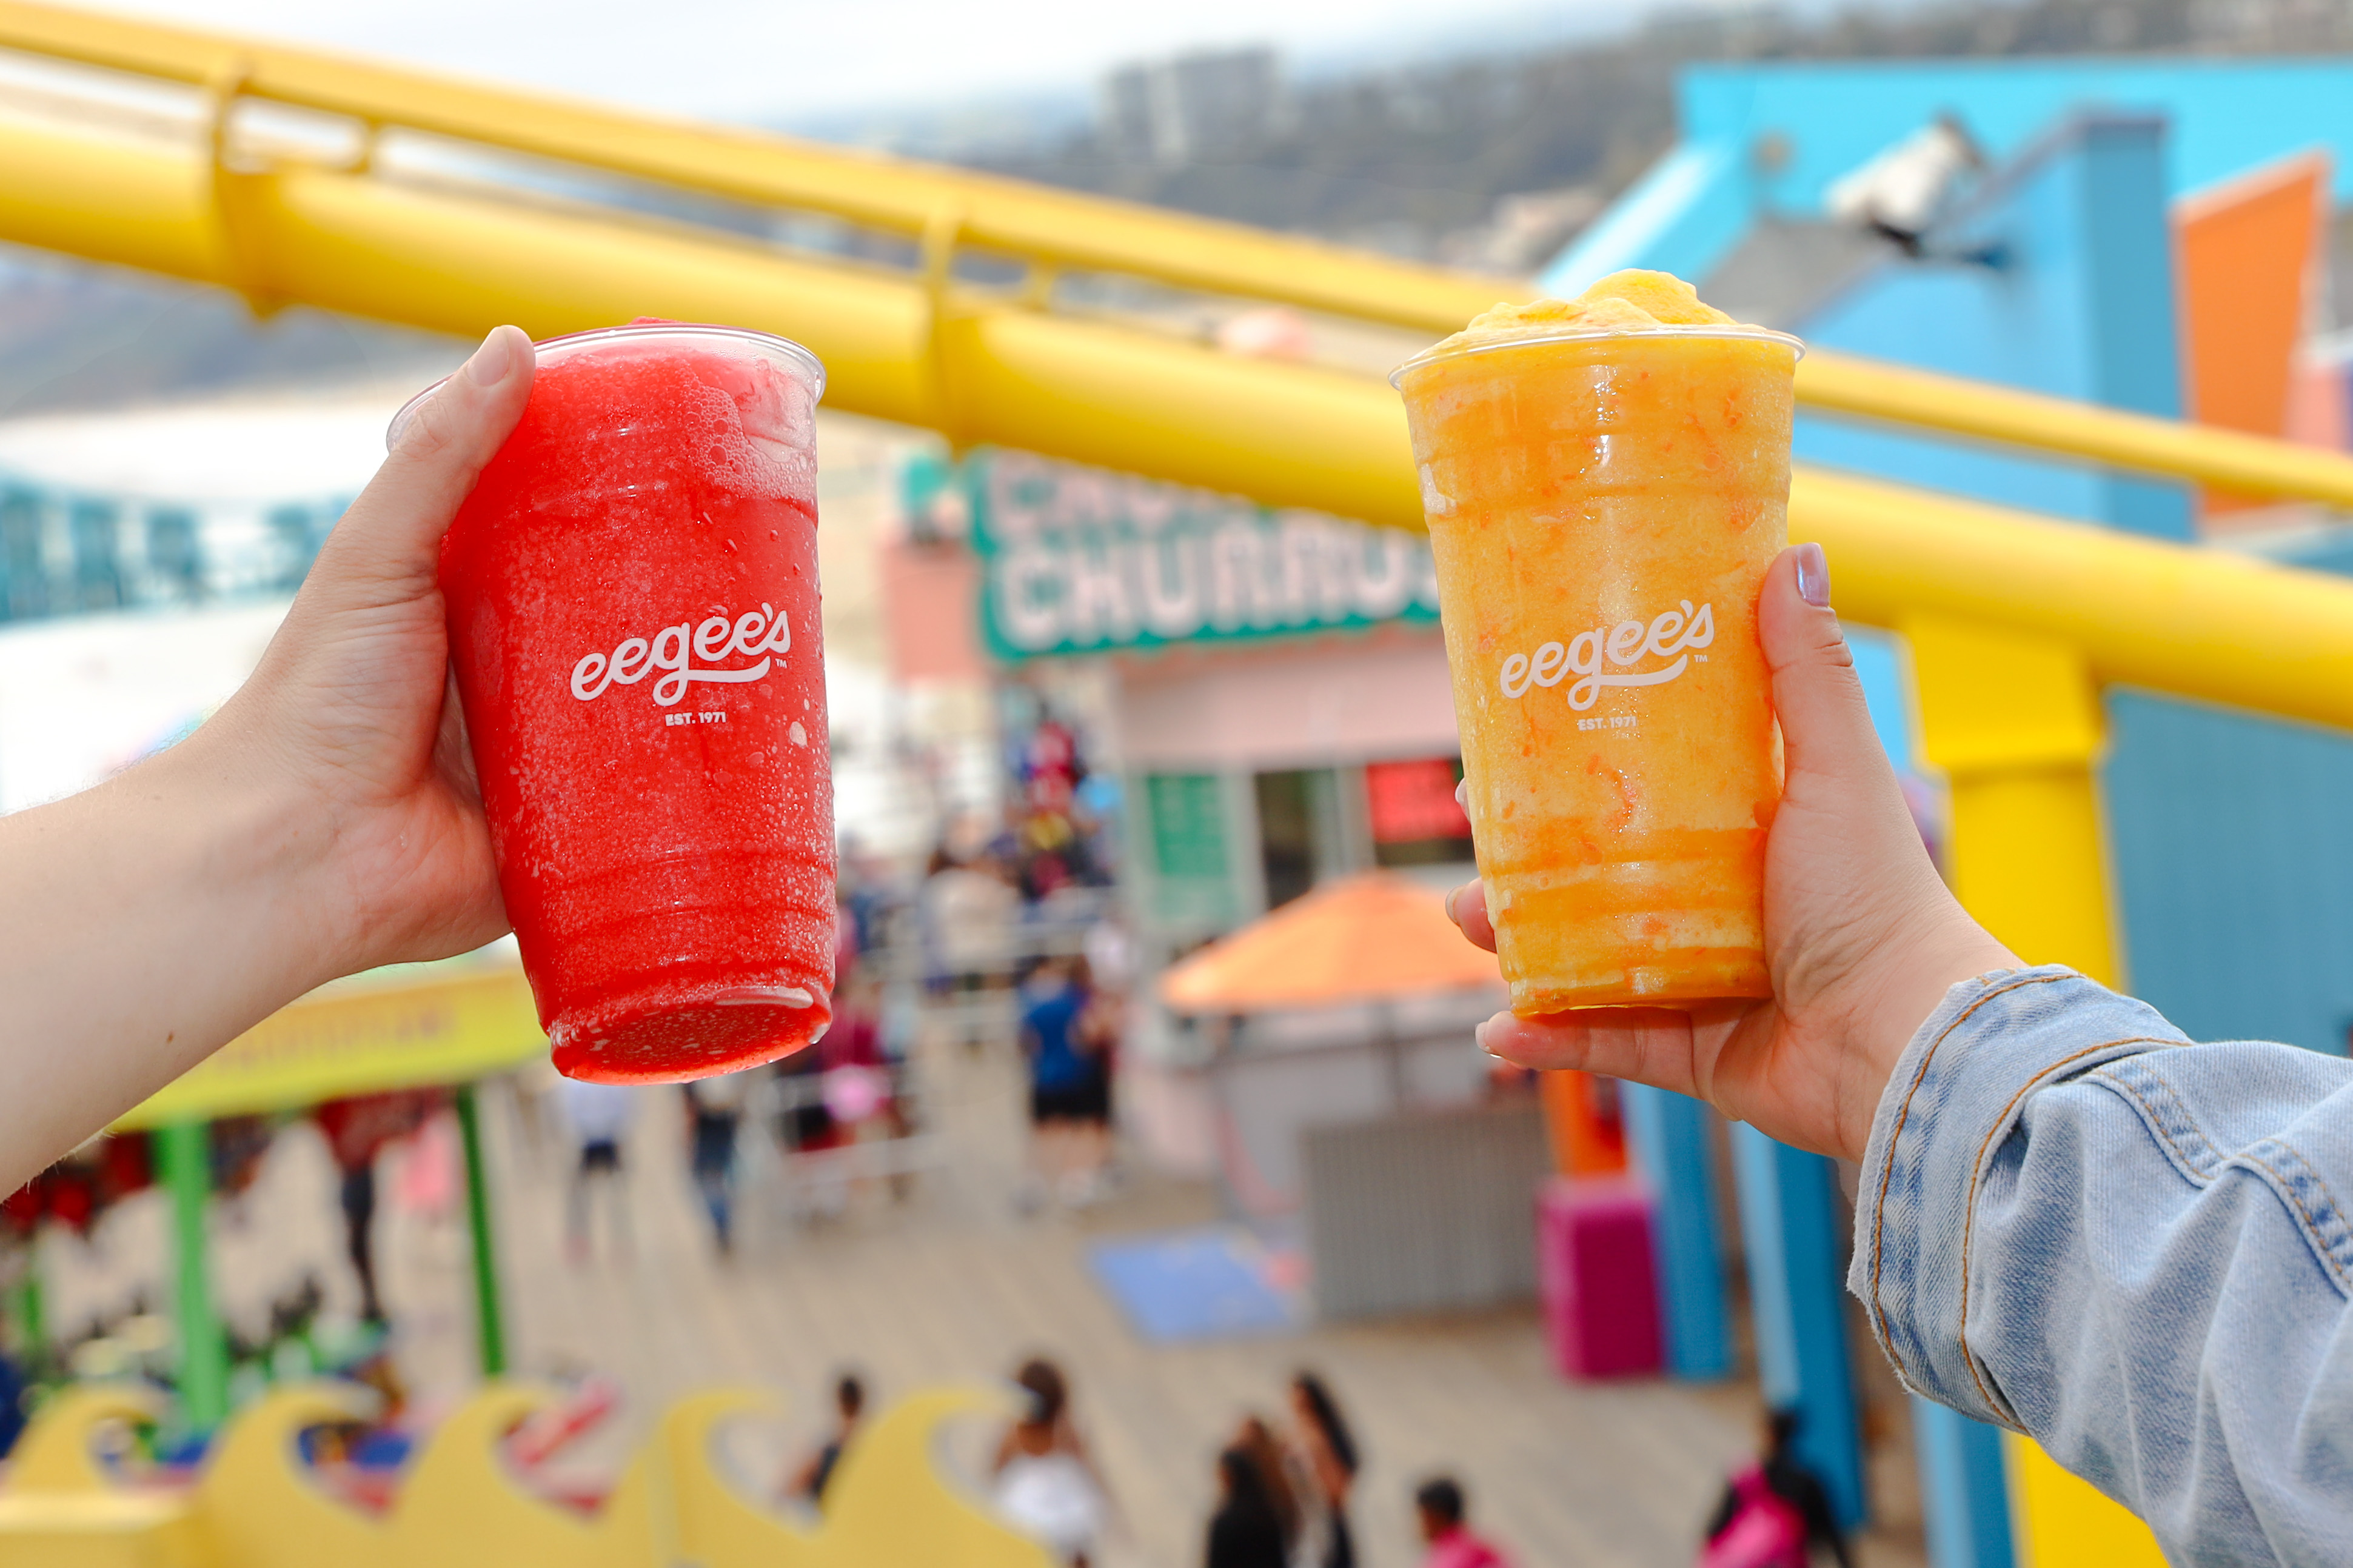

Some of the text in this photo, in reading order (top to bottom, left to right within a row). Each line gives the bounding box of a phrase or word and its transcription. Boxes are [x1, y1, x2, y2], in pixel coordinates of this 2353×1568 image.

[997, 507, 1440, 649] CHURRO
[571, 602, 791, 706] eegee's
[1500, 599, 1715, 711] eegee's
[665, 712, 726, 726] EST. 1971
[1578, 716, 1637, 731] EST. 1971
